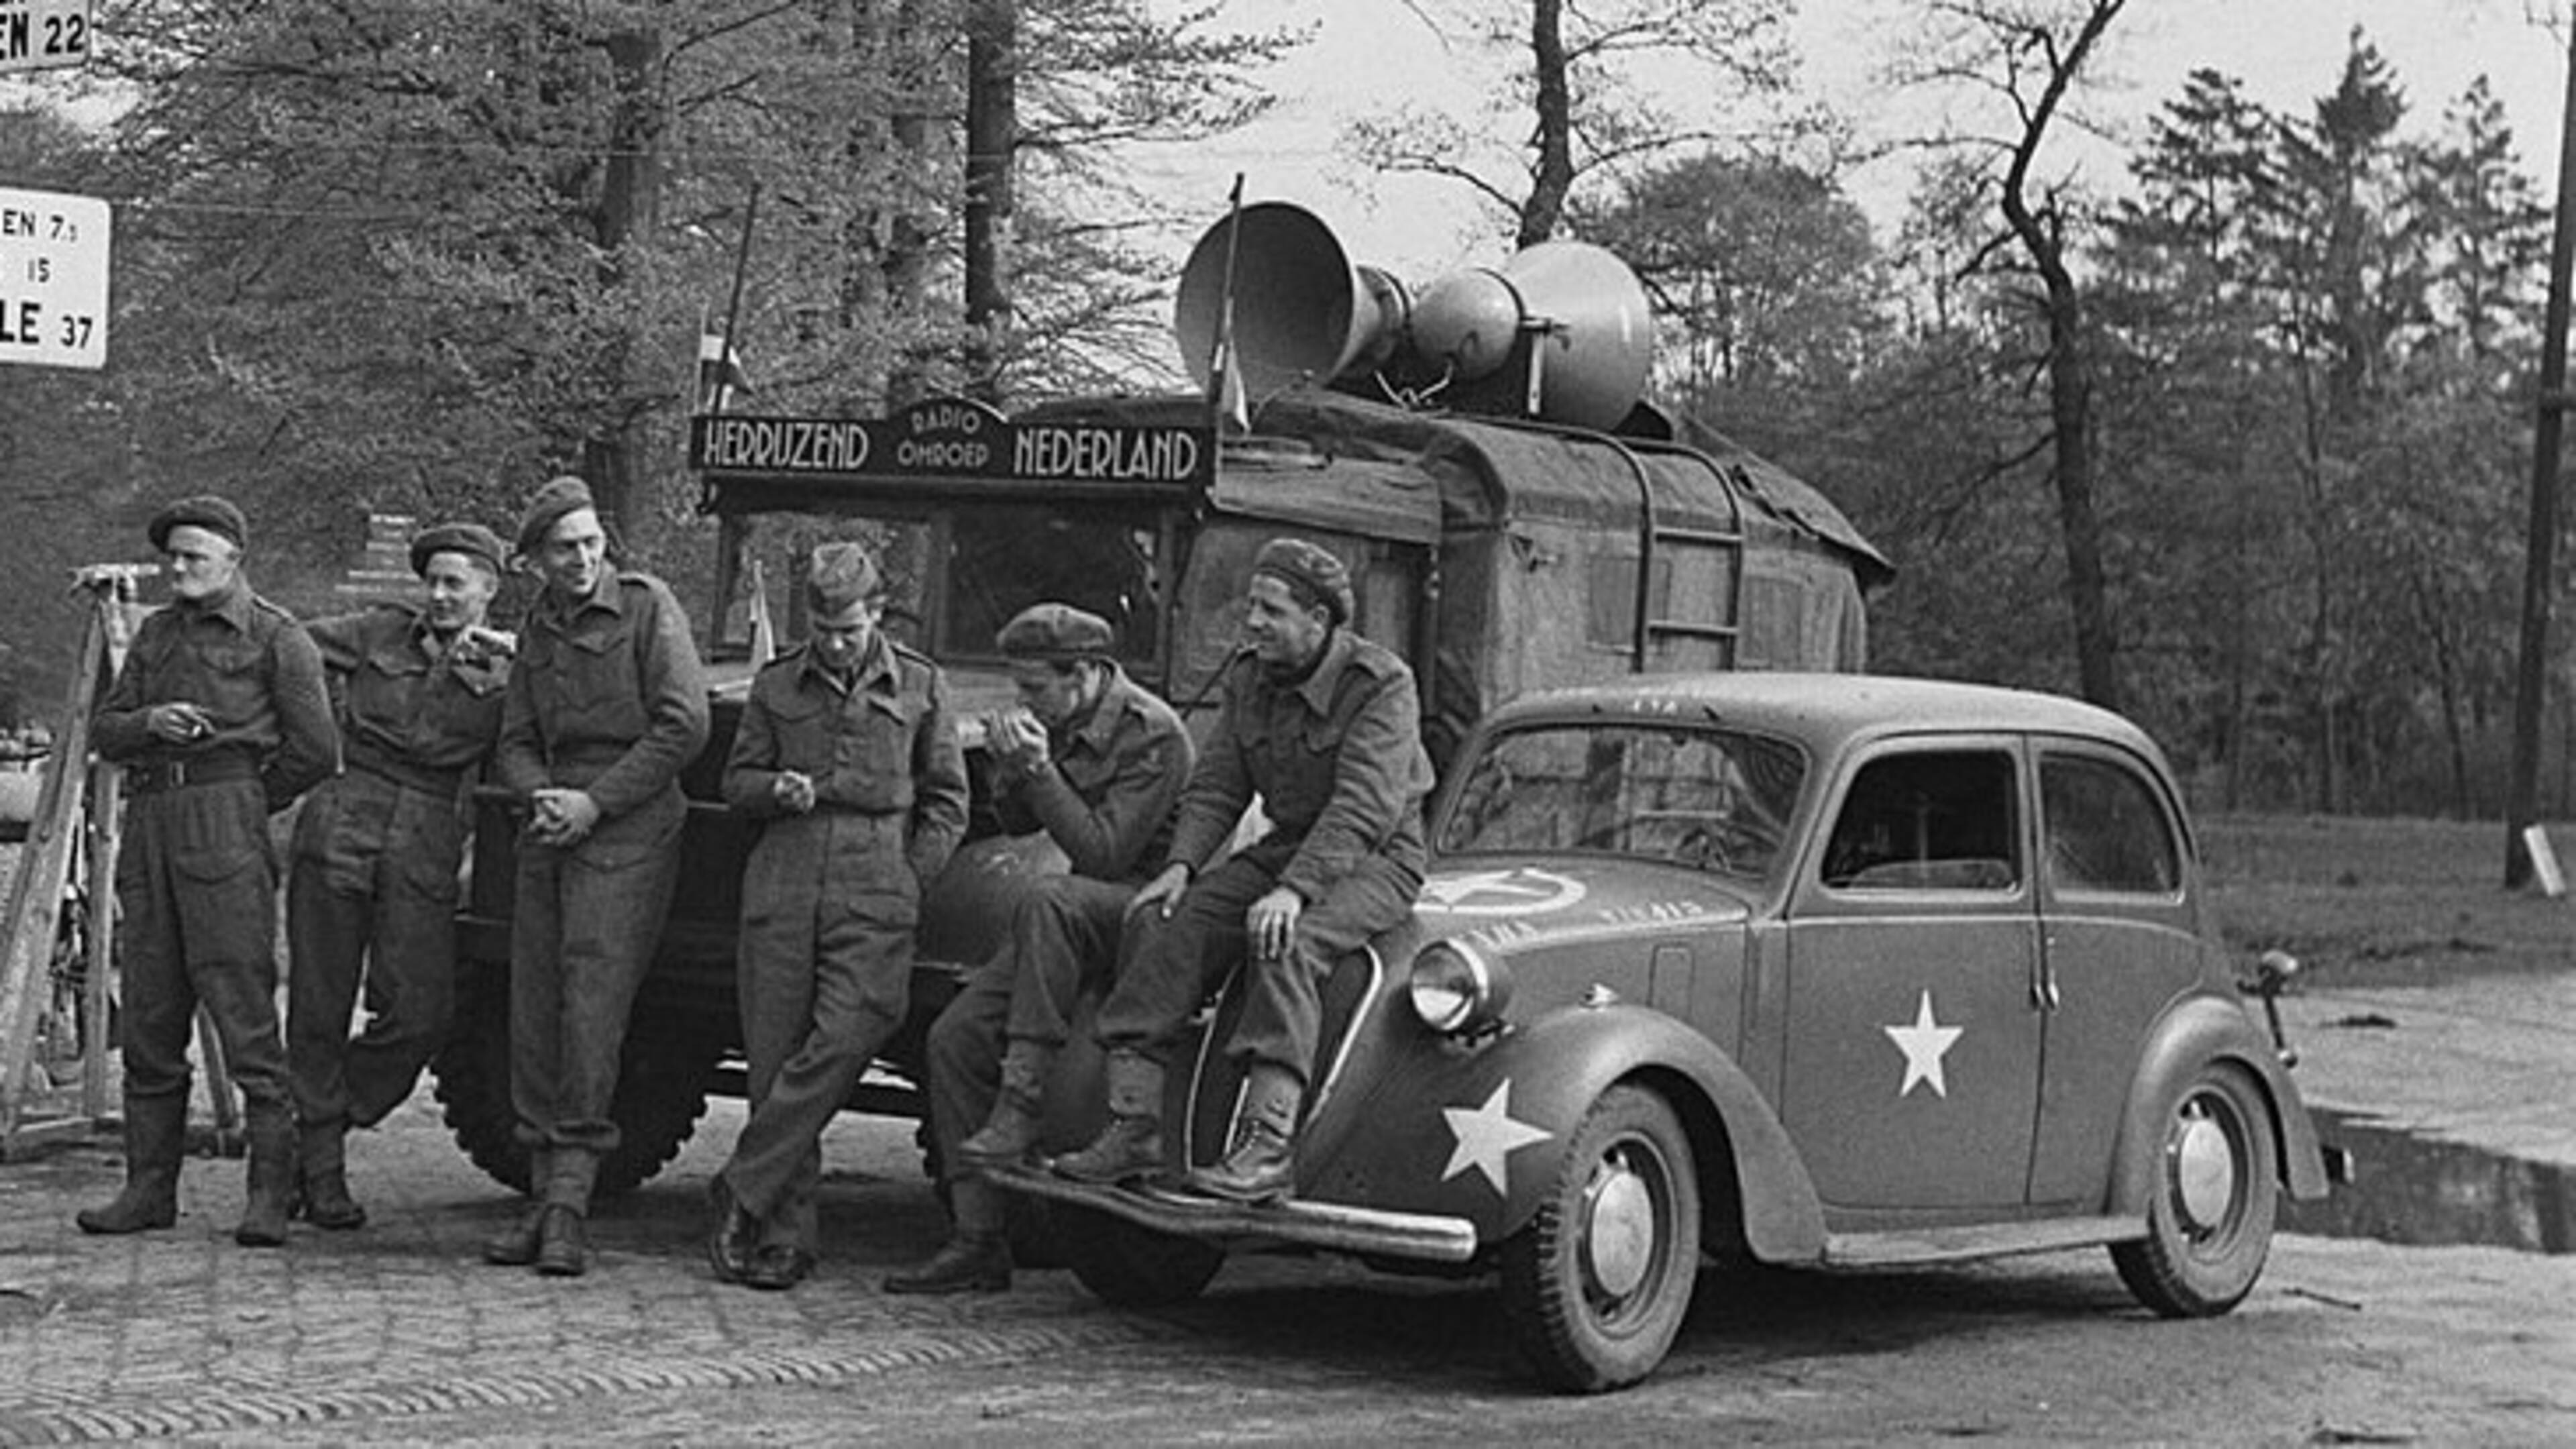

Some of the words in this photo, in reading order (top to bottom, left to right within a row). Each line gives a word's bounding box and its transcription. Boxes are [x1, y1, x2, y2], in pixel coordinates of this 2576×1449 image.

[45, 13, 84, 54] 22
[28, 257, 50, 283] 15
[60, 314, 93, 349] 37
[911, 404, 981, 435] RADIO
[897, 439, 990, 468] OMROEP
[1014, 427, 1197, 481] NEDERLAND
